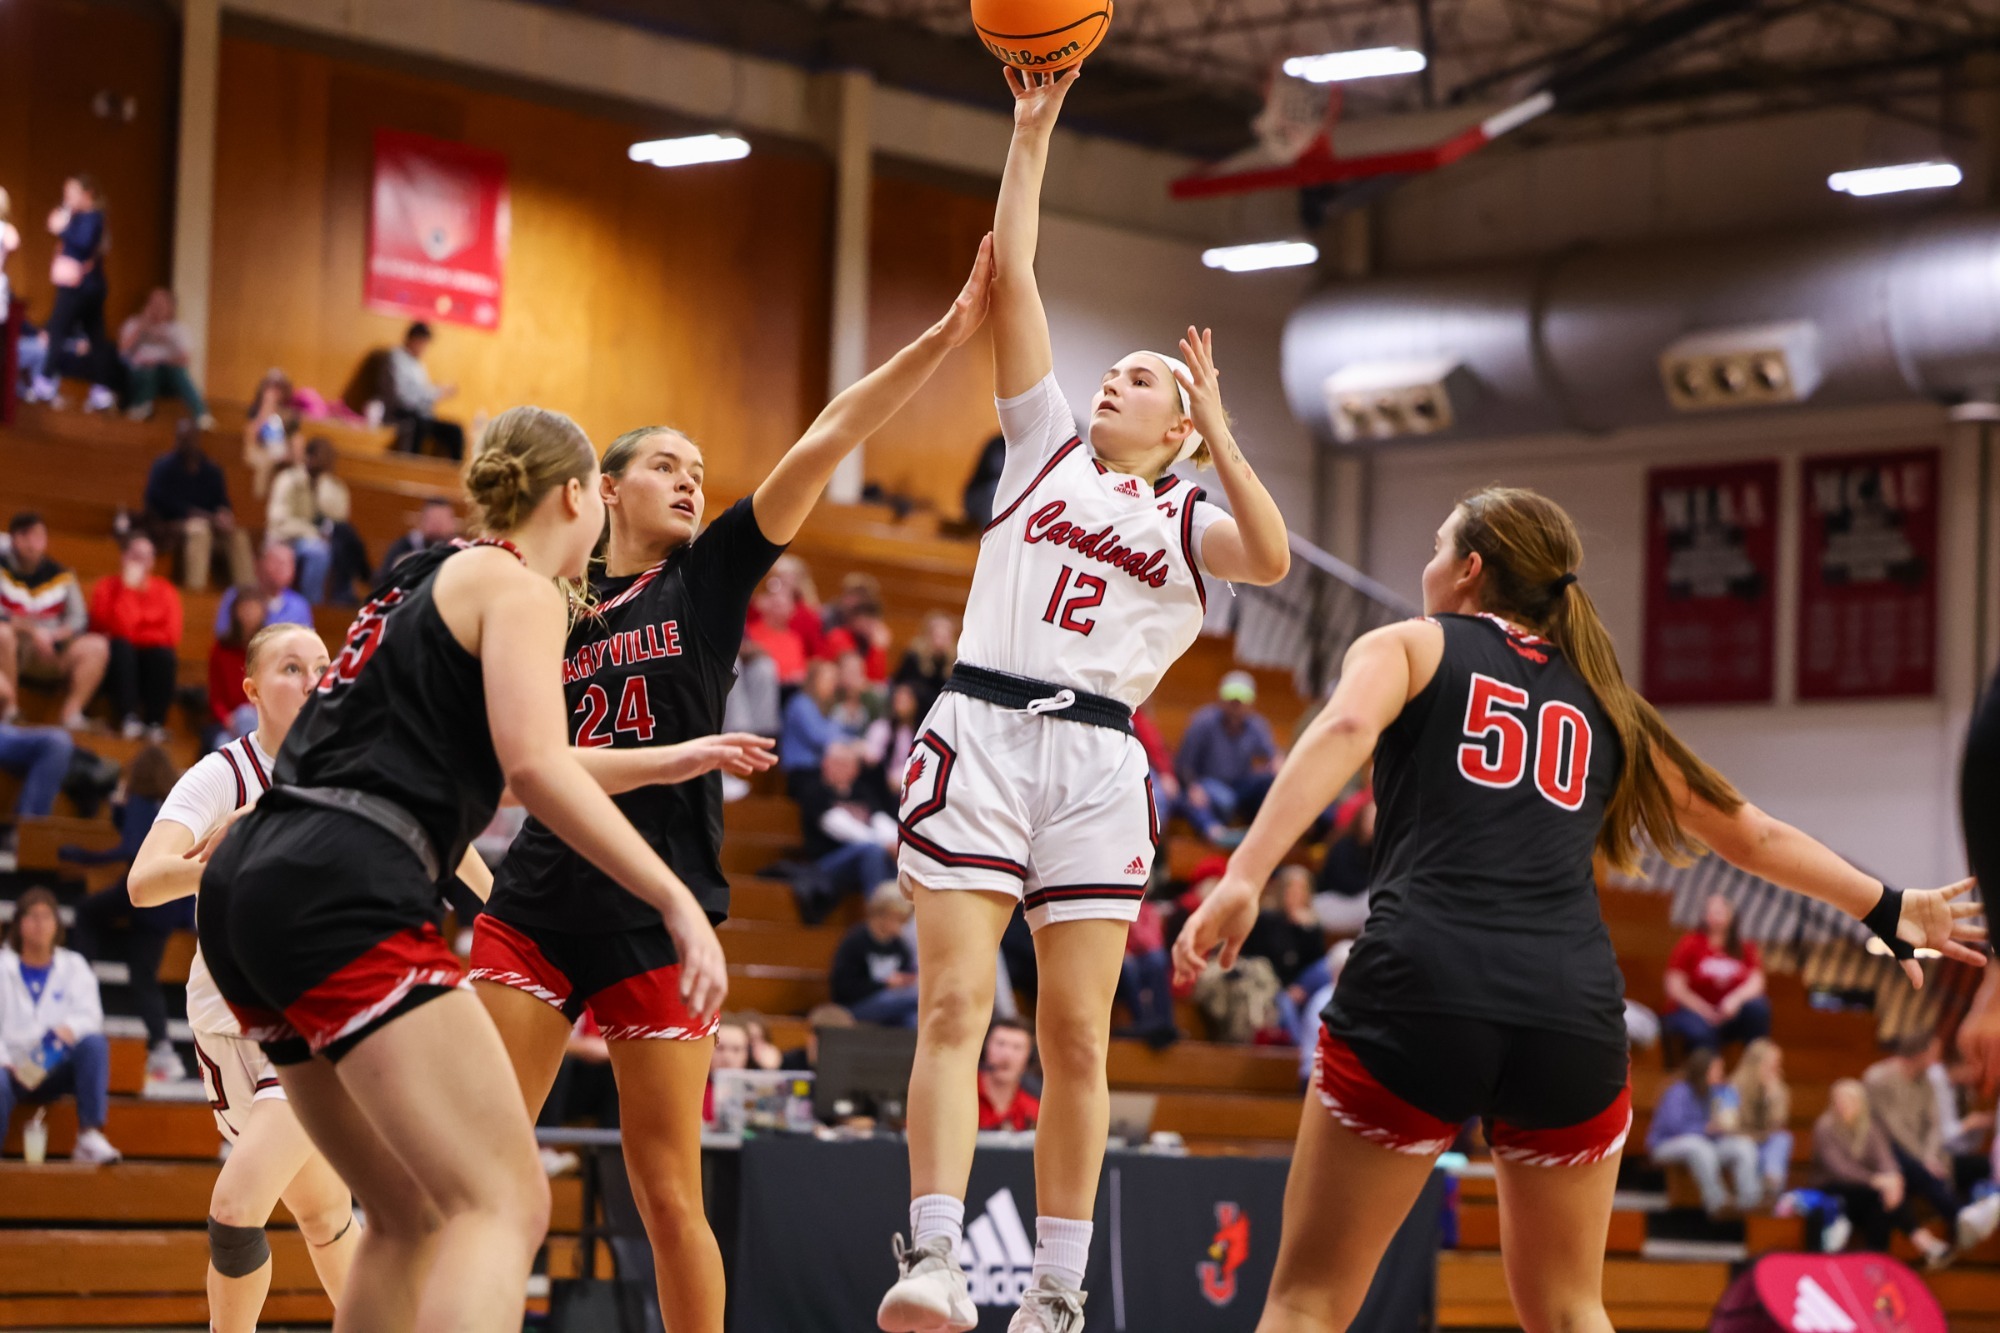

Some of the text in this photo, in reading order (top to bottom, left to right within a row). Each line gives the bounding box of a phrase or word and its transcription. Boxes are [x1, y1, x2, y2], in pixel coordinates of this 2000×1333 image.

[984, 38, 1080, 66] Wilson
[1113, 485, 1140, 498] adidas
[1024, 500, 1169, 588] Cardinals
[1042, 564, 1107, 637] 12
[562, 620, 682, 685] ARYVILLE
[575, 675, 656, 748] 24
[1457, 672, 1592, 811] 50
[962, 1263, 1034, 1307] dida
